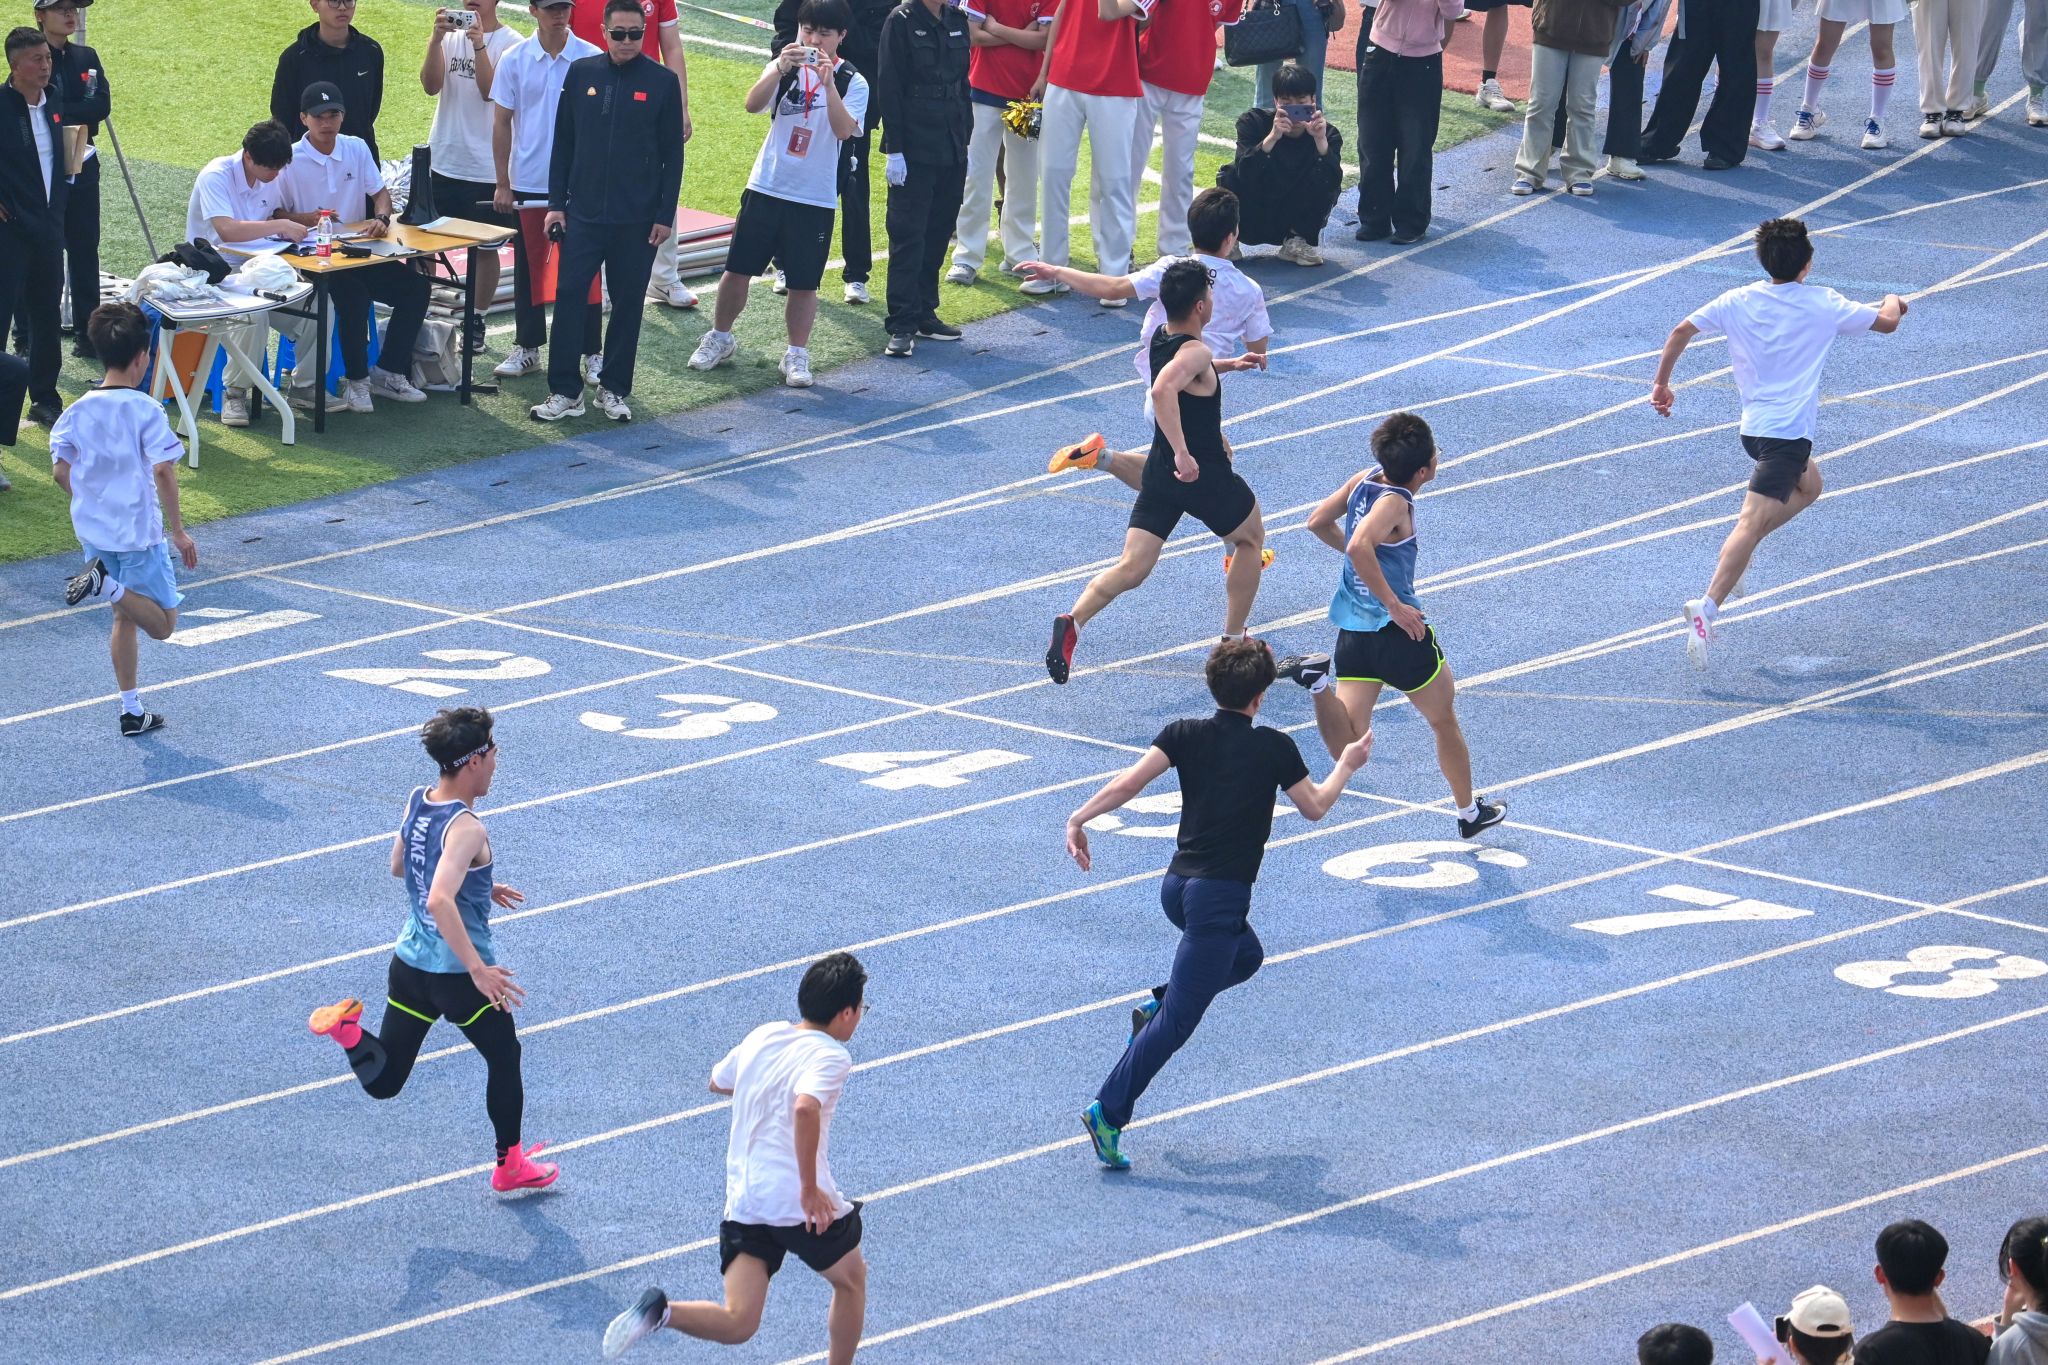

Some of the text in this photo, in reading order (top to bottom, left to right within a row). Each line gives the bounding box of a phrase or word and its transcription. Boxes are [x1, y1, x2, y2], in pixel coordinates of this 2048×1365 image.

[163, 607, 323, 647] 1
[322, 649, 552, 697] 2
[580, 693, 778, 740] 3
[817, 748, 1033, 790] 4
[410, 816, 432, 866] WAKE
[1322, 840, 1528, 889] 6
[1571, 884, 1816, 936] 7
[1834, 945, 2048, 999] 8
